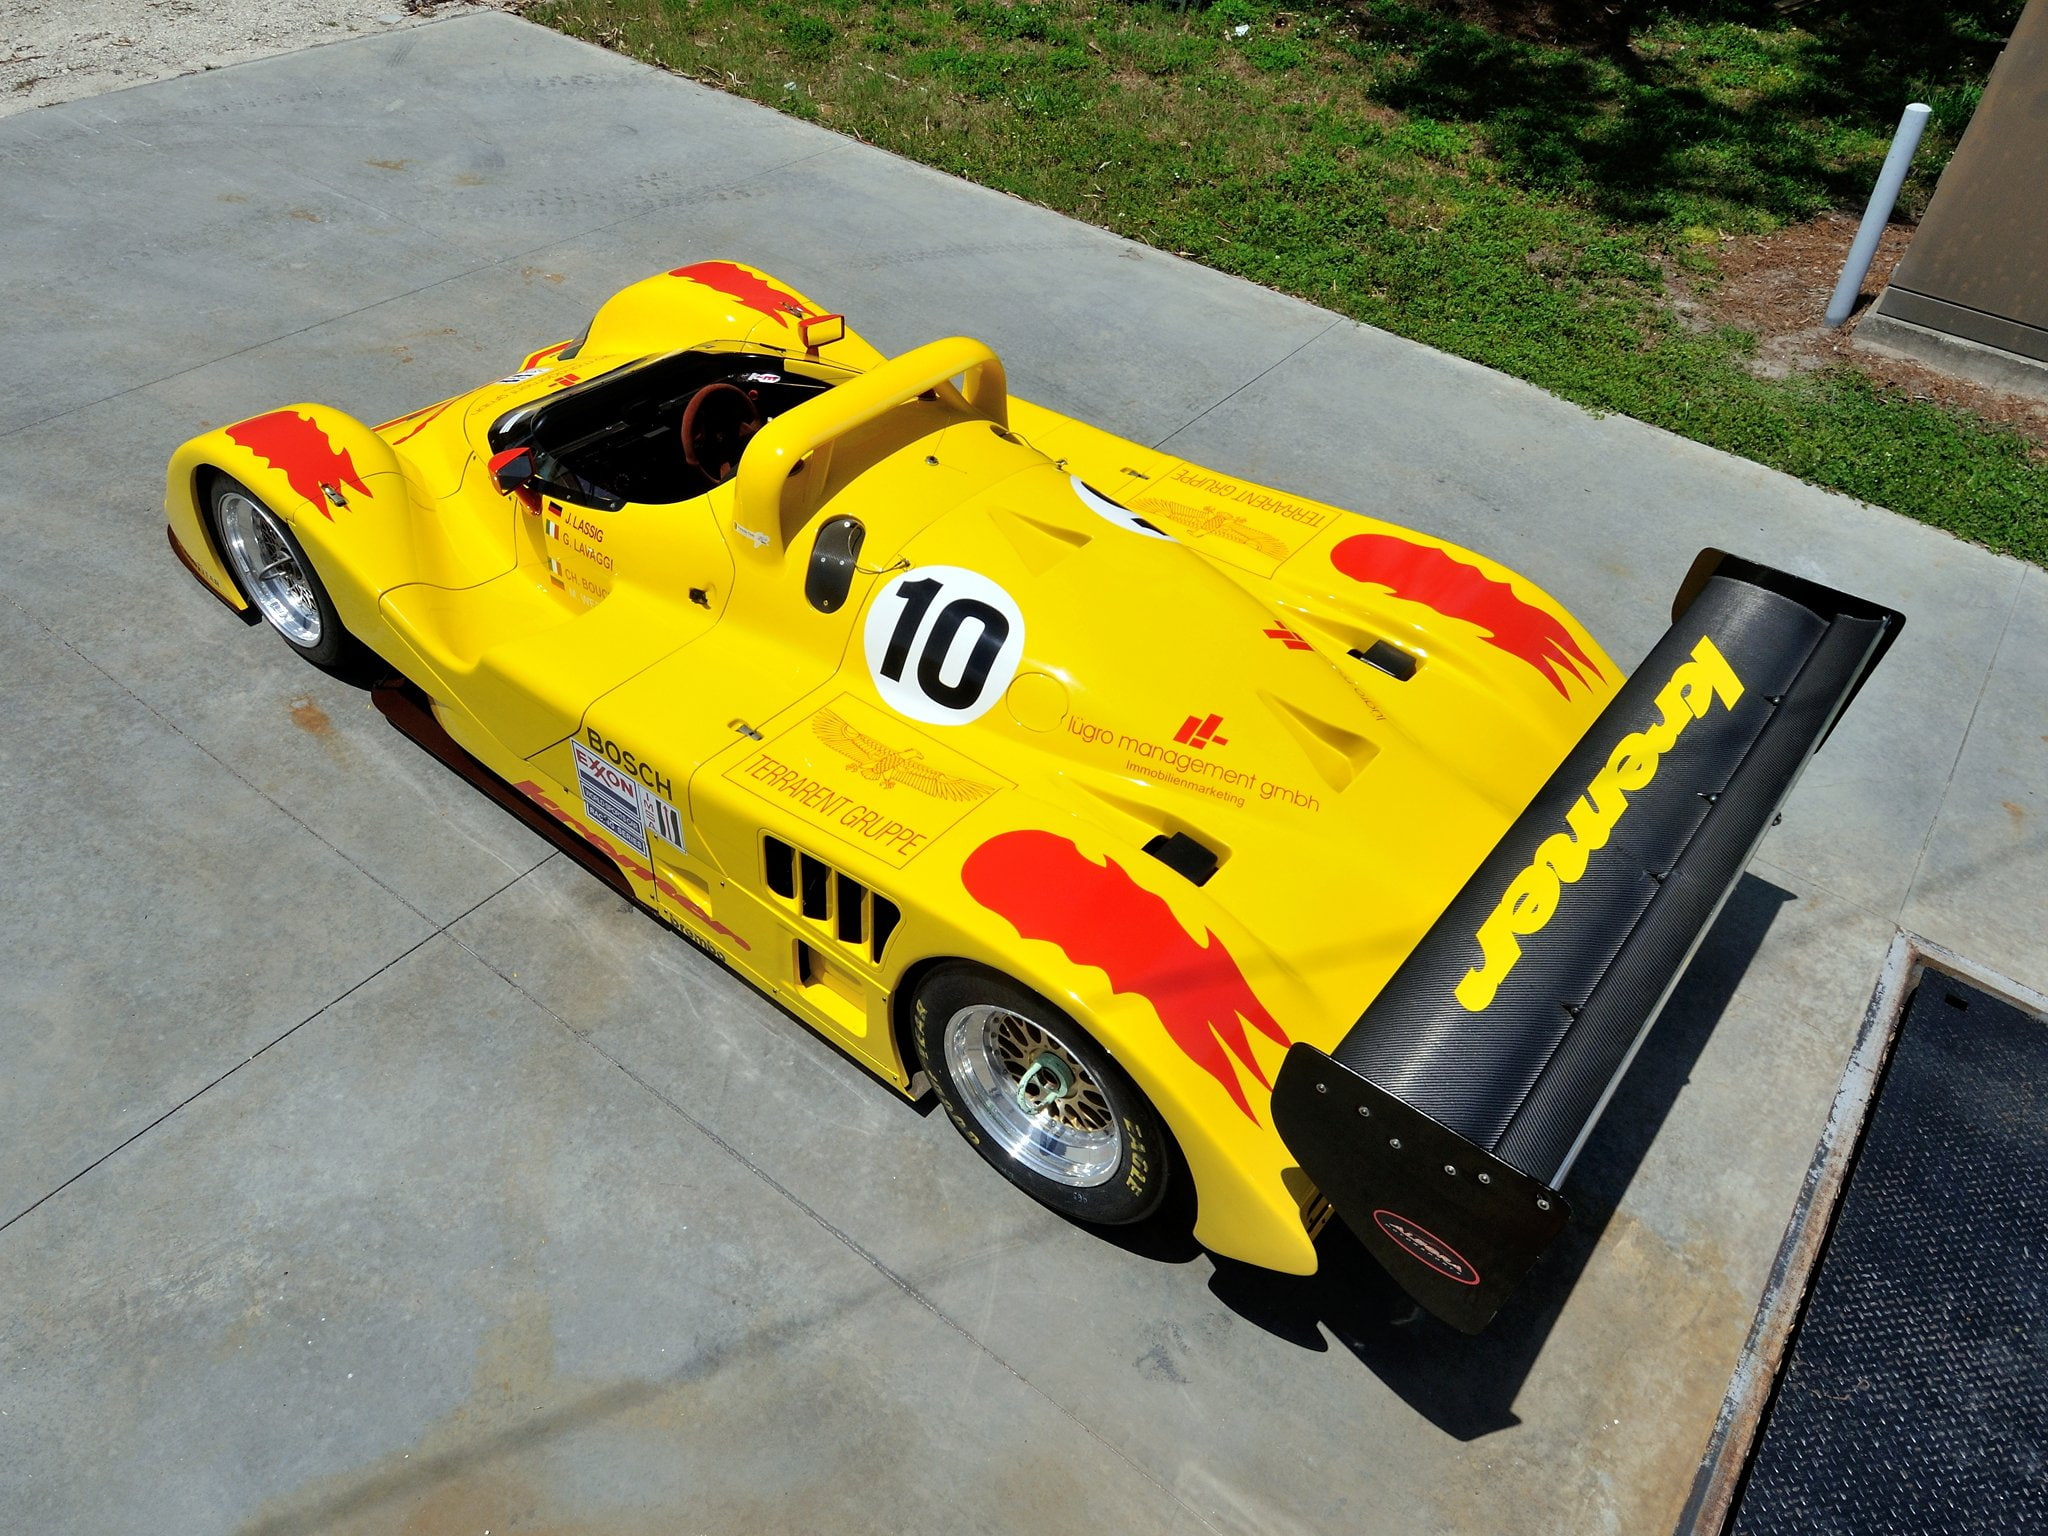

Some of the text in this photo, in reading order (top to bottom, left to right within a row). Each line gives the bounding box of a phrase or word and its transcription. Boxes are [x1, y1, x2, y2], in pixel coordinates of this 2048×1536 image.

[573, 515, 604, 543] LASSIG
[1171, 468, 1326, 529] TERRARENT GRUPPE
[563, 533, 614, 572] G. LAVAGGI
[582, 578, 610, 600] BOUC
[880, 577, 1010, 710] 10
[576, 748, 634, 798] EXXON
[587, 727, 673, 801] BOSCH
[1067, 714, 1320, 812] lügro management gmbh
[1125, 758, 1246, 809] Immobilienmarketing
[744, 753, 928, 856] TERRARENT GRUPPE
[1454, 635, 1745, 1012] kremer
[669, 913, 728, 963] brembo
[1123, 1116, 1150, 1198] EAGLE
